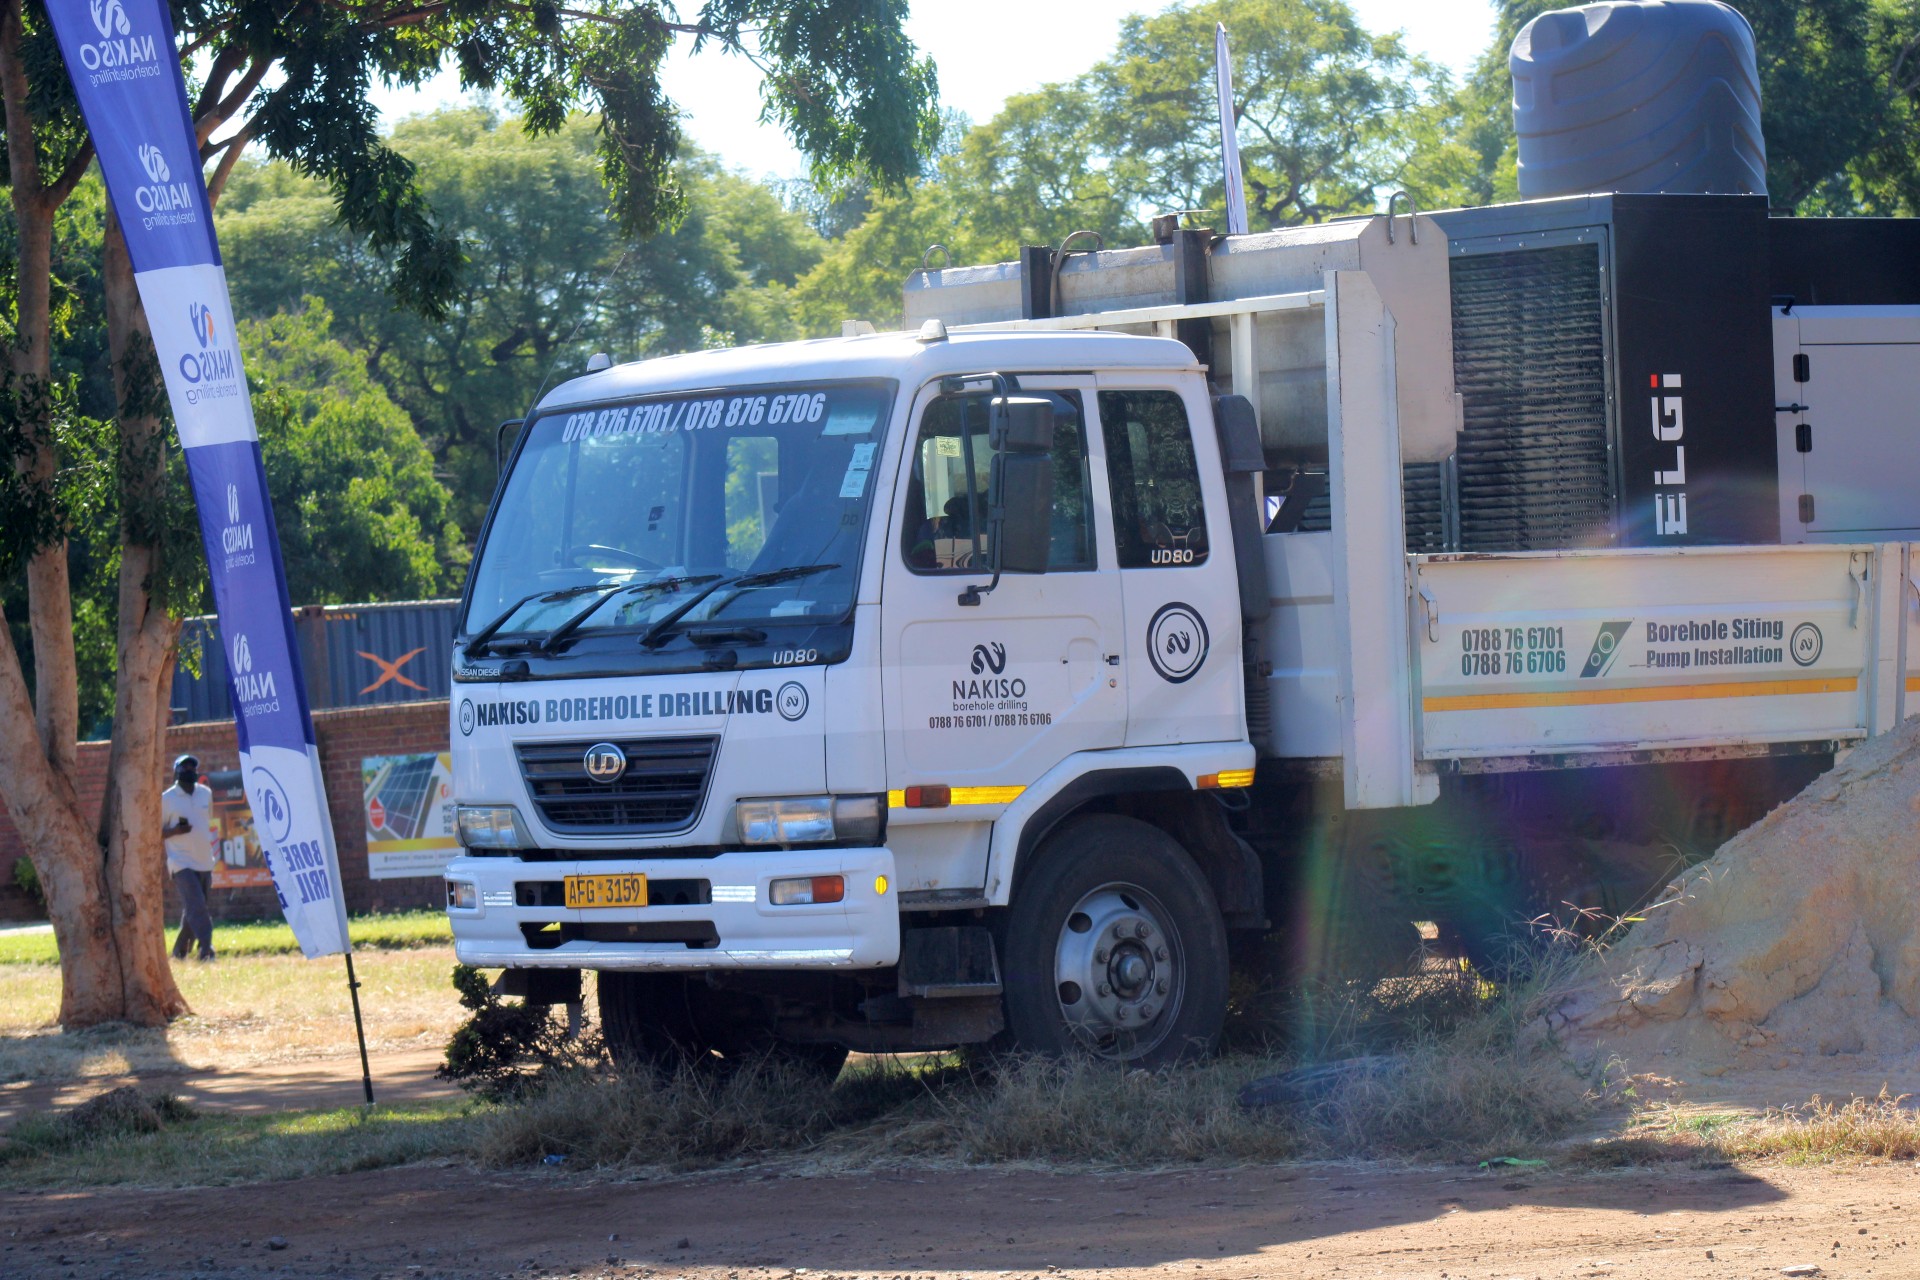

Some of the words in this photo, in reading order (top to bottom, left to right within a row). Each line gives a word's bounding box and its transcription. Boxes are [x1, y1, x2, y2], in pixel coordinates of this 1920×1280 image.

[562, 414, 593, 444] 078
[594, 409, 629, 438] 876
[627, 403, 672, 433] 6701
[685, 398, 723, 431] 078
[725, 396, 765, 428] 876
[767, 392, 826, 425] 6706
[1151, 549, 1194, 564] UD80
[1461, 626, 1501, 652] 0788
[1504, 626, 1524, 650] 76
[1526, 625, 1564, 649] 6701
[1646, 618, 1728, 643] Borehole
[1731, 617, 1784, 641] Siting
[772, 648, 818, 666] UD80
[1461, 651, 1501, 676] 0788
[1504, 650, 1524, 674] 76
[1526, 649, 1566, 673] 6706
[1646, 648, 1691, 669] Pump
[1694, 645, 1783, 666] Installation
[478, 668, 500, 677] DIESEL
[953, 678, 1026, 700] NAKISO
[477, 700, 540, 727] NAKISO
[545, 693, 653, 722] BOREHOLE
[658, 688, 773, 718] DRILLING
[953, 701, 995, 712] borehole
[997, 700, 1028, 712] drilling
[929, 716, 952, 729] 0788
[953, 716, 964, 728] 76
[966, 715, 986, 728] 6701
[994, 714, 1016, 726] 0788
[1018, 714, 1028, 726] 76
[1030, 713, 1052, 725] 6706
[588, 752, 620, 775] UD
[569, 879, 595, 904] AFG
[605, 878, 640, 903] 3159
